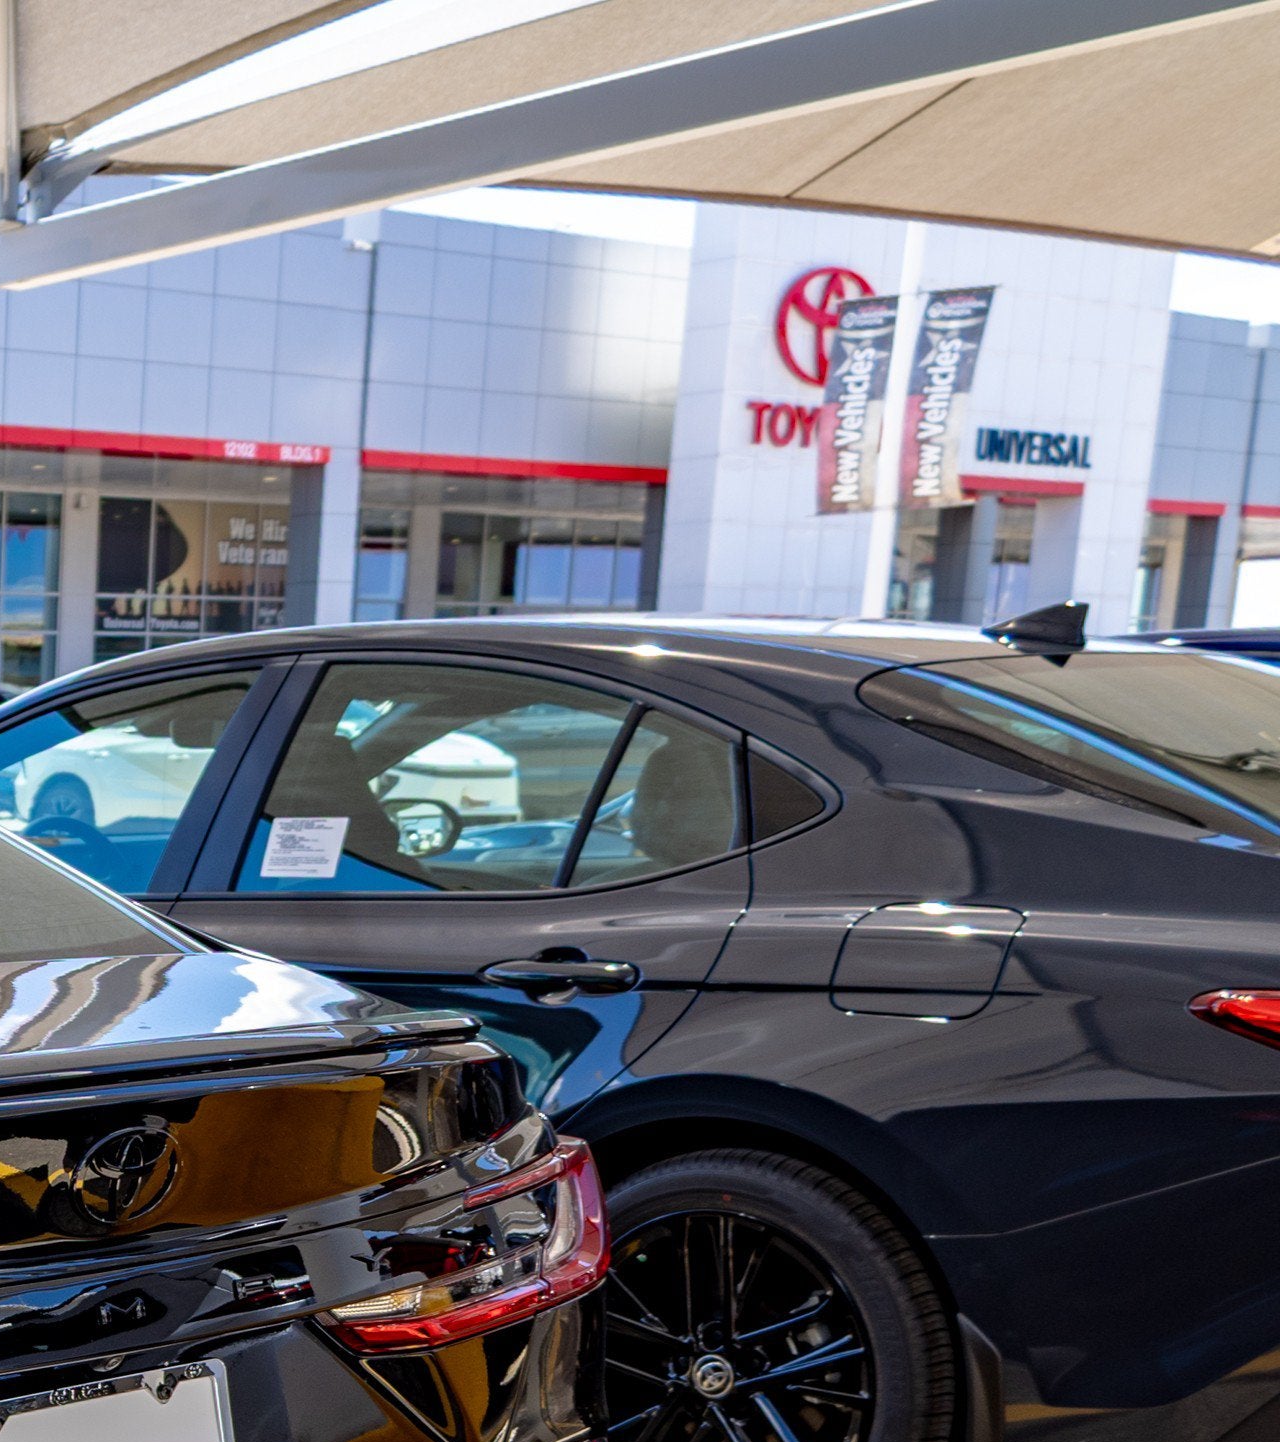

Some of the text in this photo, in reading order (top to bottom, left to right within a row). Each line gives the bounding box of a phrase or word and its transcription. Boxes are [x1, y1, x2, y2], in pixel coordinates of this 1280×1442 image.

[833, 347, 877, 447] Vehicles
[916, 338, 963, 440] Vehicles
[913, 443, 942, 497] New
[975, 427, 1092, 470] UNIVERSAL
[831, 450, 861, 503] New
[218, 541, 289, 566] Veteran
[230, 518, 288, 542] We Hir
